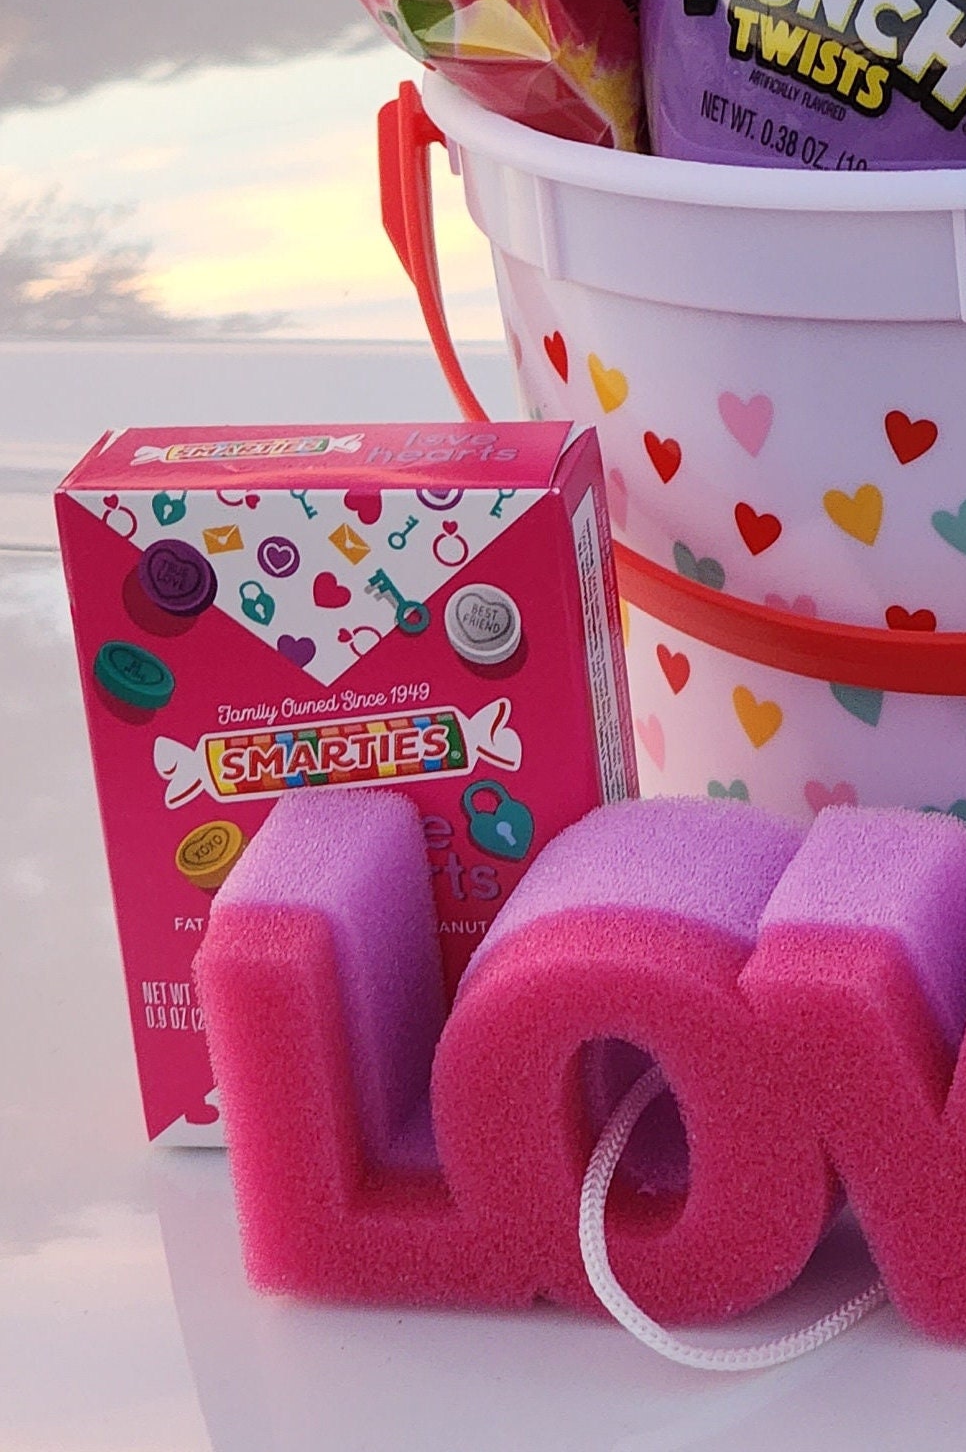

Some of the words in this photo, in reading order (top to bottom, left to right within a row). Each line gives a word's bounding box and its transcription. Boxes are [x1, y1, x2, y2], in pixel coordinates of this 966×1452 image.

[731, 5, 890, 109] TWISTS
[749, 69, 800, 101] ARTIFICIALLY
[801, 91, 847, 122] FLAVORED
[700, 89, 729, 125] NET
[731, 102, 757, 140] WT.
[760, 118, 798, 157] 0.38
[404, 430, 498, 448] love
[365, 444, 519, 465] hearts
[463, 613, 500, 634] FRIEND
[471, 604, 498, 621] BEST
[218, 704, 279, 726] Family
[281, 695, 340, 718] Owned
[390, 681, 430, 703] 1949
[219, 724, 449, 785] SMARTIES
[192, 834, 224, 861] XOXO
[174, 917, 204, 932] FAT
[435, 920, 488, 935] ANUT
[142, 981, 167, 1004] NET
[169, 983, 191, 1006] WT
[145, 1006, 167, 1029] 0.9
[169, 1006, 189, 1031] OZ
